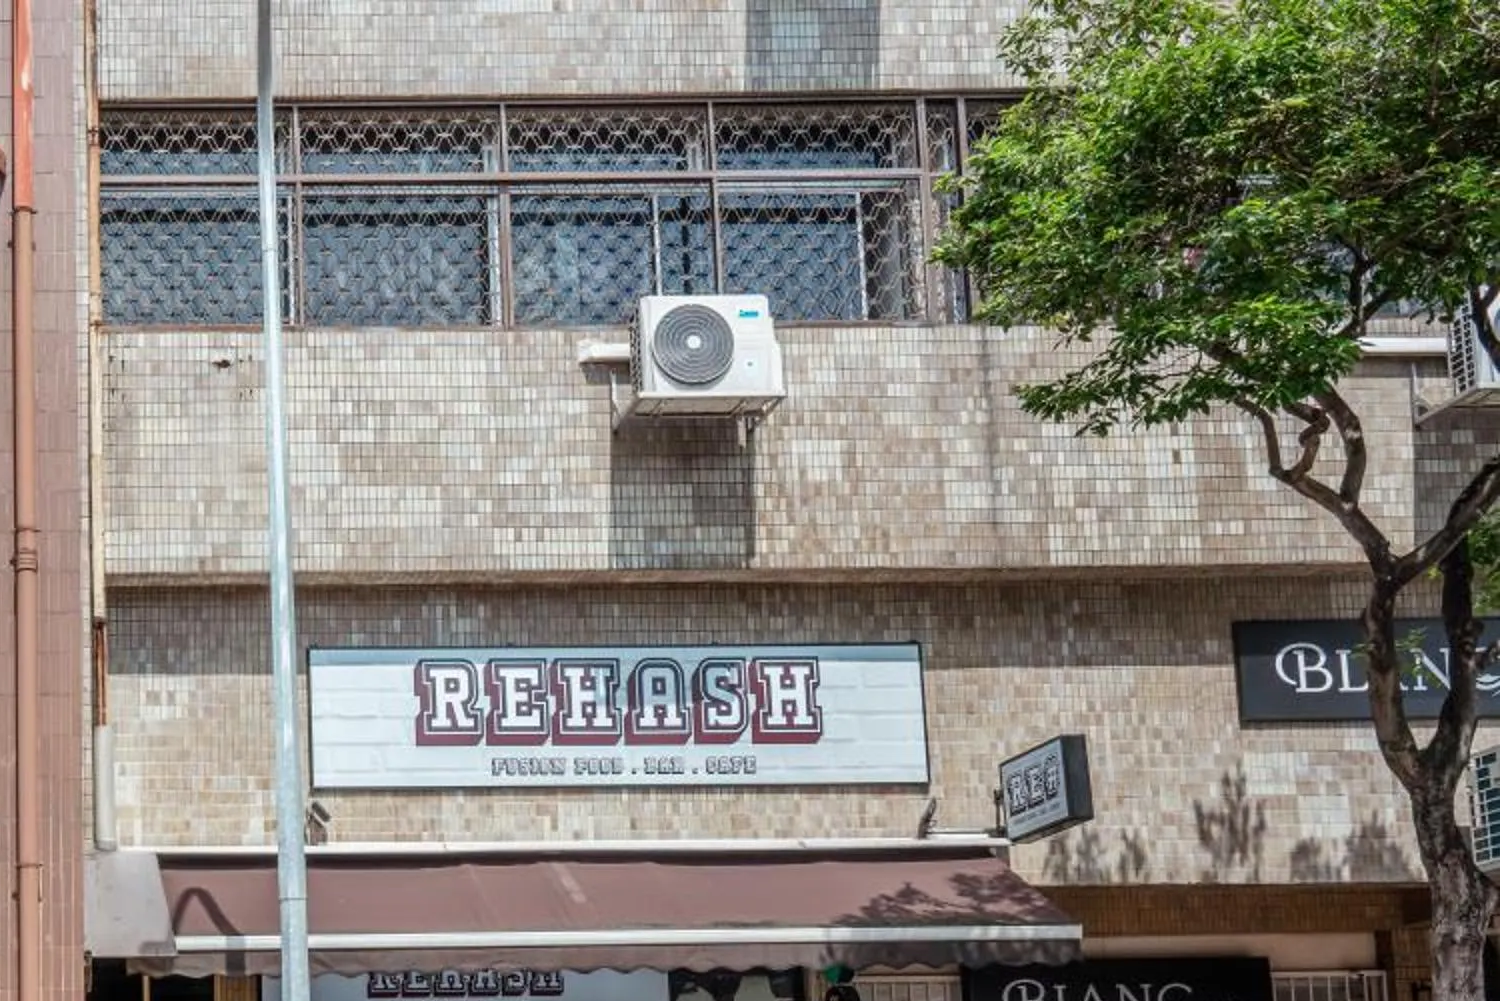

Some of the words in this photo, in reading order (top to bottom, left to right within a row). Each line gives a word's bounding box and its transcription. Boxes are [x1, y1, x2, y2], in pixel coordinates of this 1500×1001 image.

[1275, 642, 1500, 698] BLN
[414, 656, 824, 746] REHASH
[491, 756, 566, 776] FUSION
[574, 756, 624, 775] FOOD
[643, 756, 684, 774] BAR
[705, 755, 758, 774] CAFE
